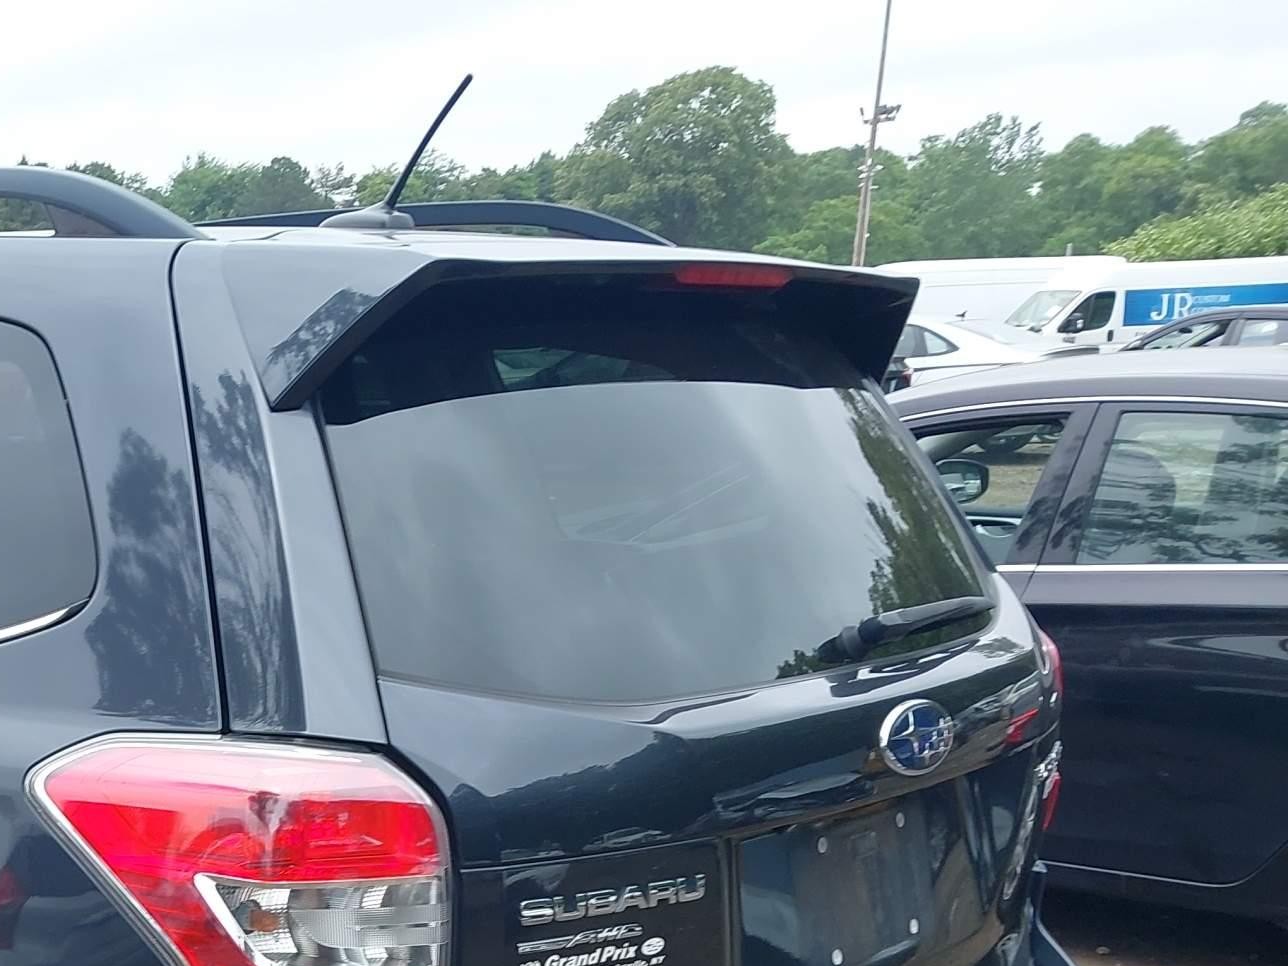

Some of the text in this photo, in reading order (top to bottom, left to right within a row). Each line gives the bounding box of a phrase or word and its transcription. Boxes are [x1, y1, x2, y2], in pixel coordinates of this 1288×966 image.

[1149, 292, 1193, 321] JR
[520, 874, 705, 926] SUBARU
[600, 942, 639, 963] Prix
